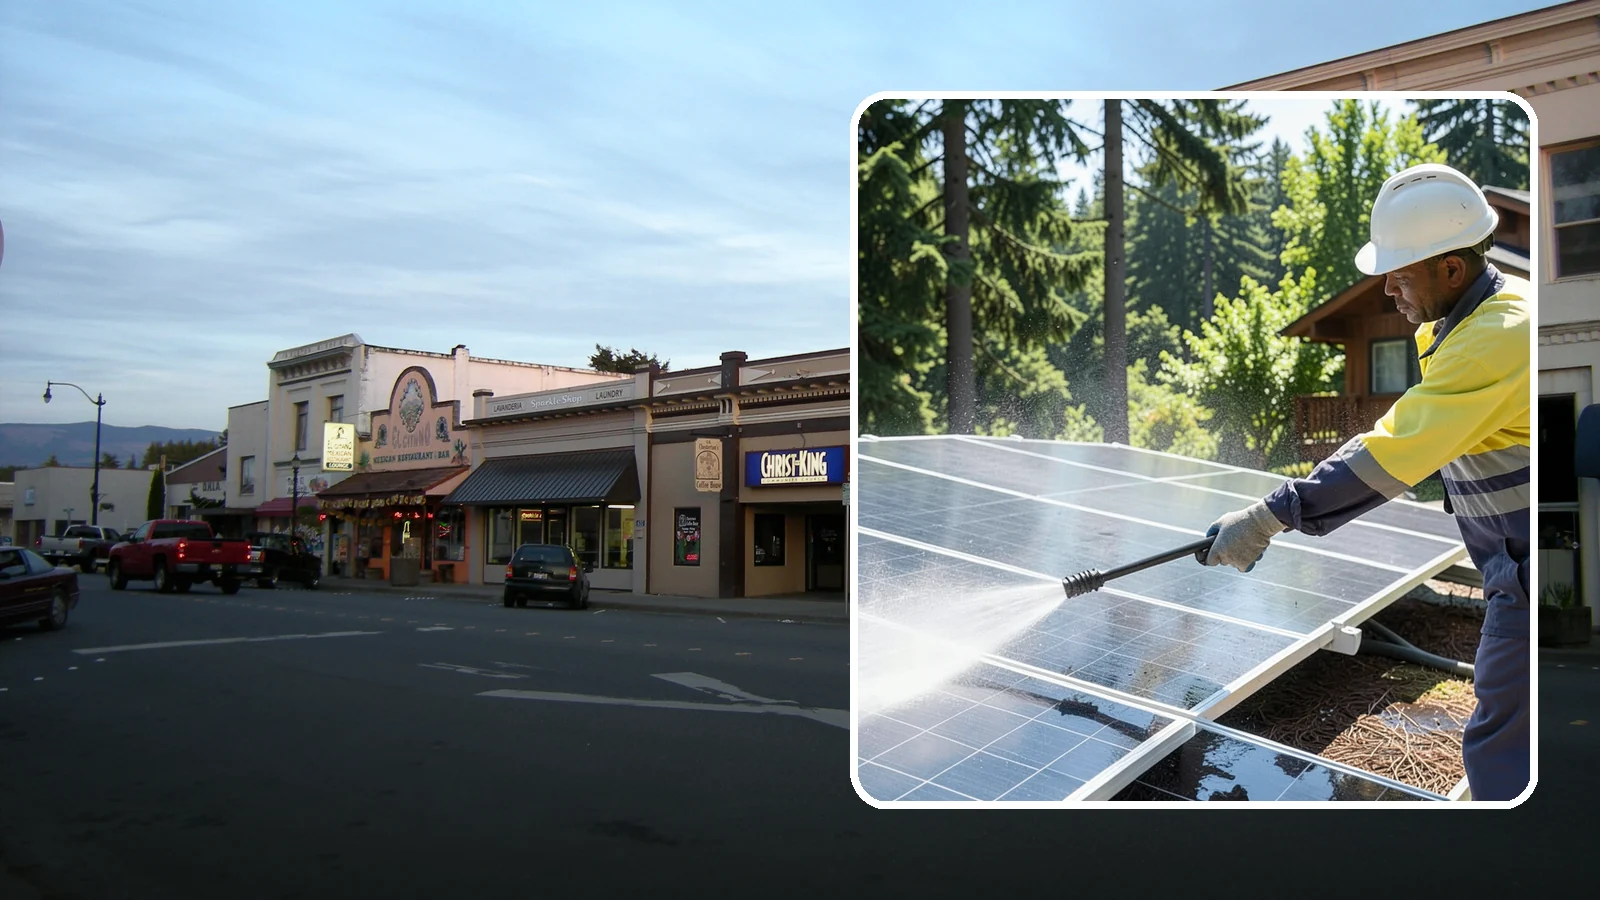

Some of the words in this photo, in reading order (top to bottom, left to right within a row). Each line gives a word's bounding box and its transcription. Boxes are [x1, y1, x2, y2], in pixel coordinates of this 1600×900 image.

[595, 388, 624, 400] LAUNDRY
[493, 402, 522, 413] LAVANDERIA
[530, 398, 560, 409] Sparkle
[562, 394, 583, 407] Shop
[373, 455, 396, 464] MEXICAN
[397, 451, 434, 462] RESTAURANT
[438, 450, 450, 459] BAR
[761, 452, 798, 478] CHRIST
[799, 449, 828, 476] KING
[696, 480, 709, 489] Coffee
